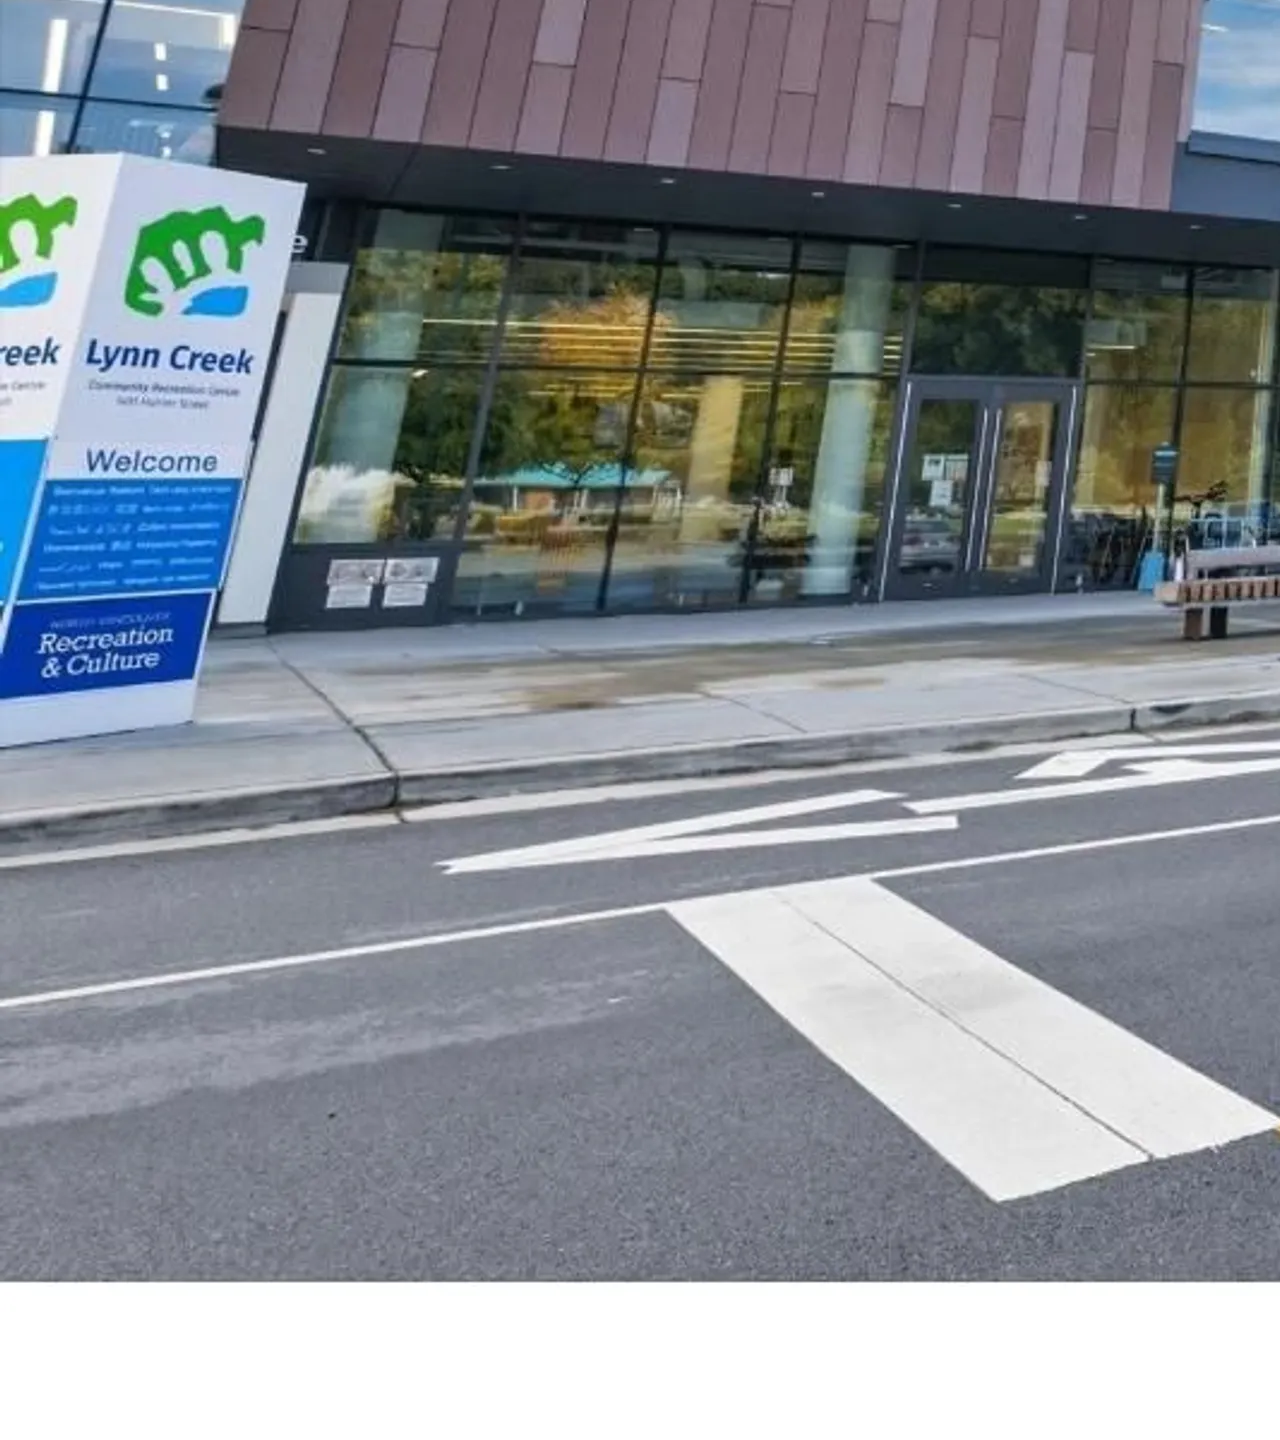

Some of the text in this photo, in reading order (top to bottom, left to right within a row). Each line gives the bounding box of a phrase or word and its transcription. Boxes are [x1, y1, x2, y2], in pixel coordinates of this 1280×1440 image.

[86, 338, 254, 374] Lynn Creek
[86, 448, 218, 473] Welcome
[37, 626, 174, 655] Recreation
[41, 651, 160, 678] & Culture
